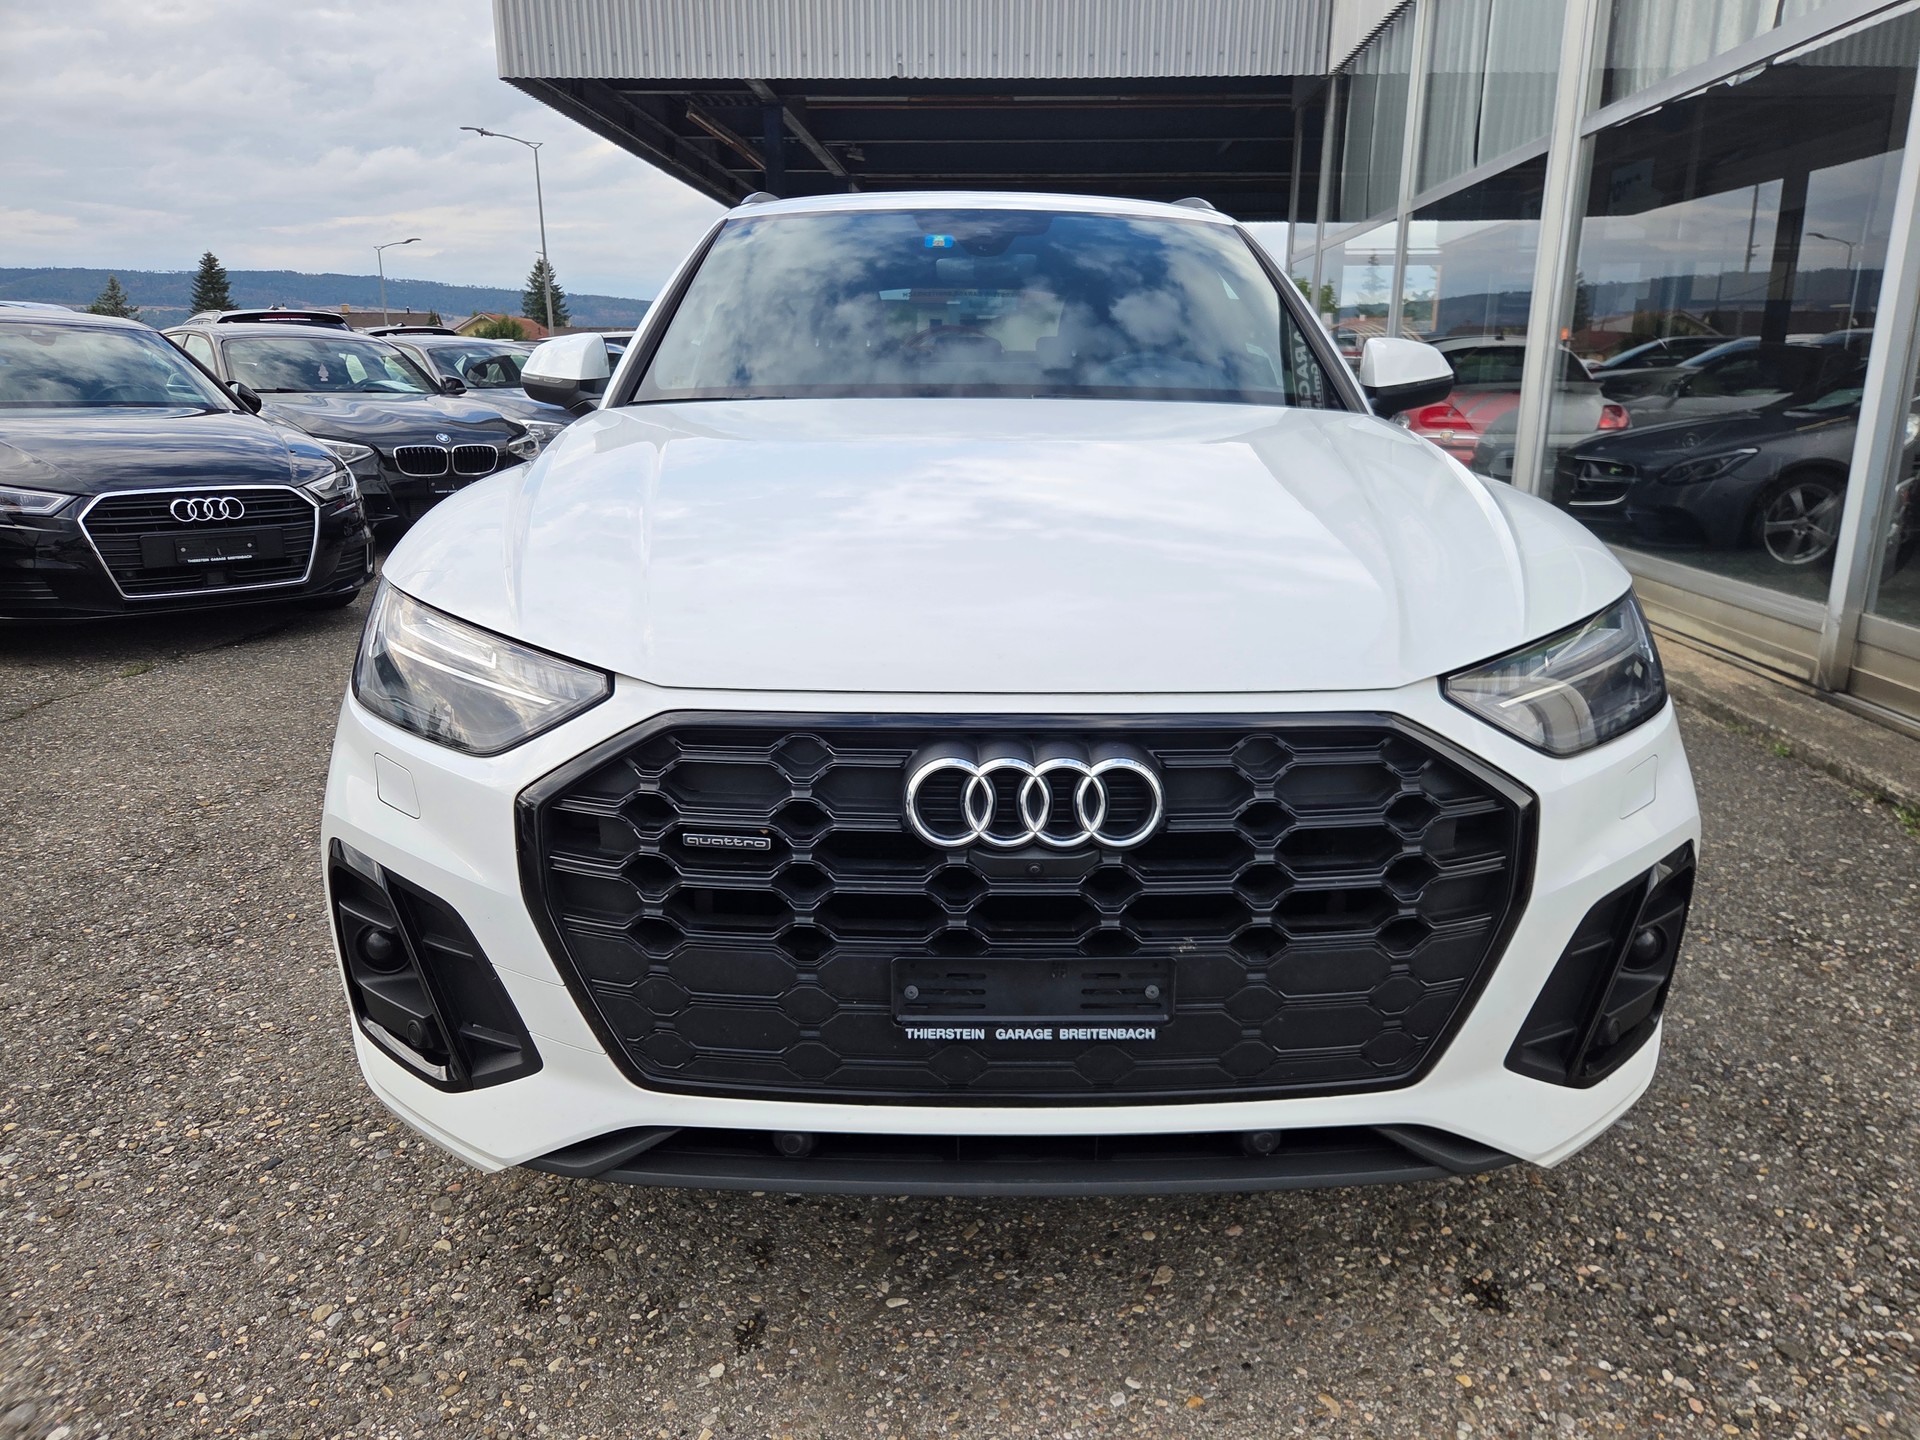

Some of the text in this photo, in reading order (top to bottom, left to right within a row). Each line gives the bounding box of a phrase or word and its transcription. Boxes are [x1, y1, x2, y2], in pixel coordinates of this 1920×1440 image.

[686, 837, 767, 848] quattro
[905, 1028, 1156, 1040] THIERSTEIN GARAGE BREITENBACH
